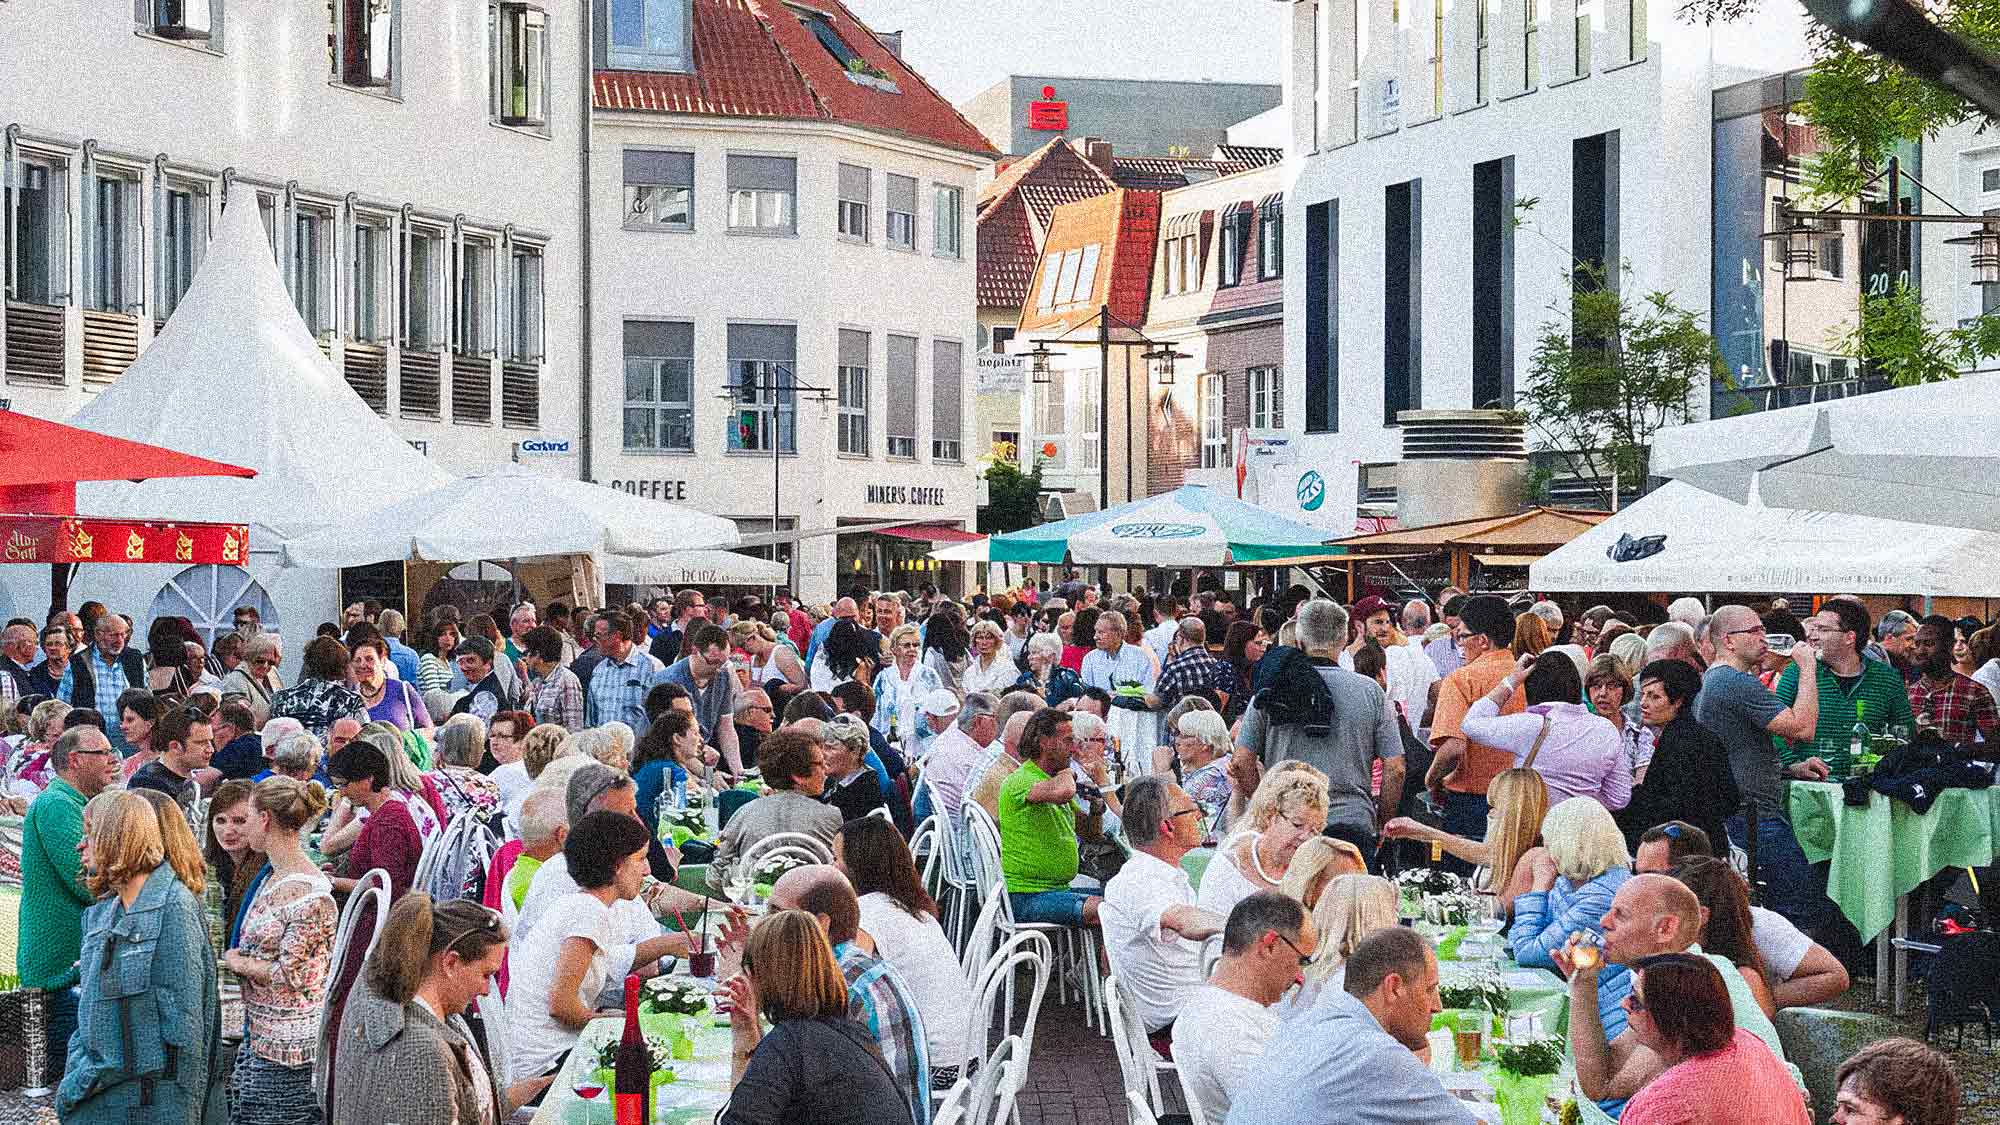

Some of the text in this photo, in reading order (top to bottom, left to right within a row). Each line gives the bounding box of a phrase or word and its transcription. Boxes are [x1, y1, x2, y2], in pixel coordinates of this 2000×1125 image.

[522, 440, 569, 451] Gerland
[867, 484, 944, 505] MINER'S COFFEE
